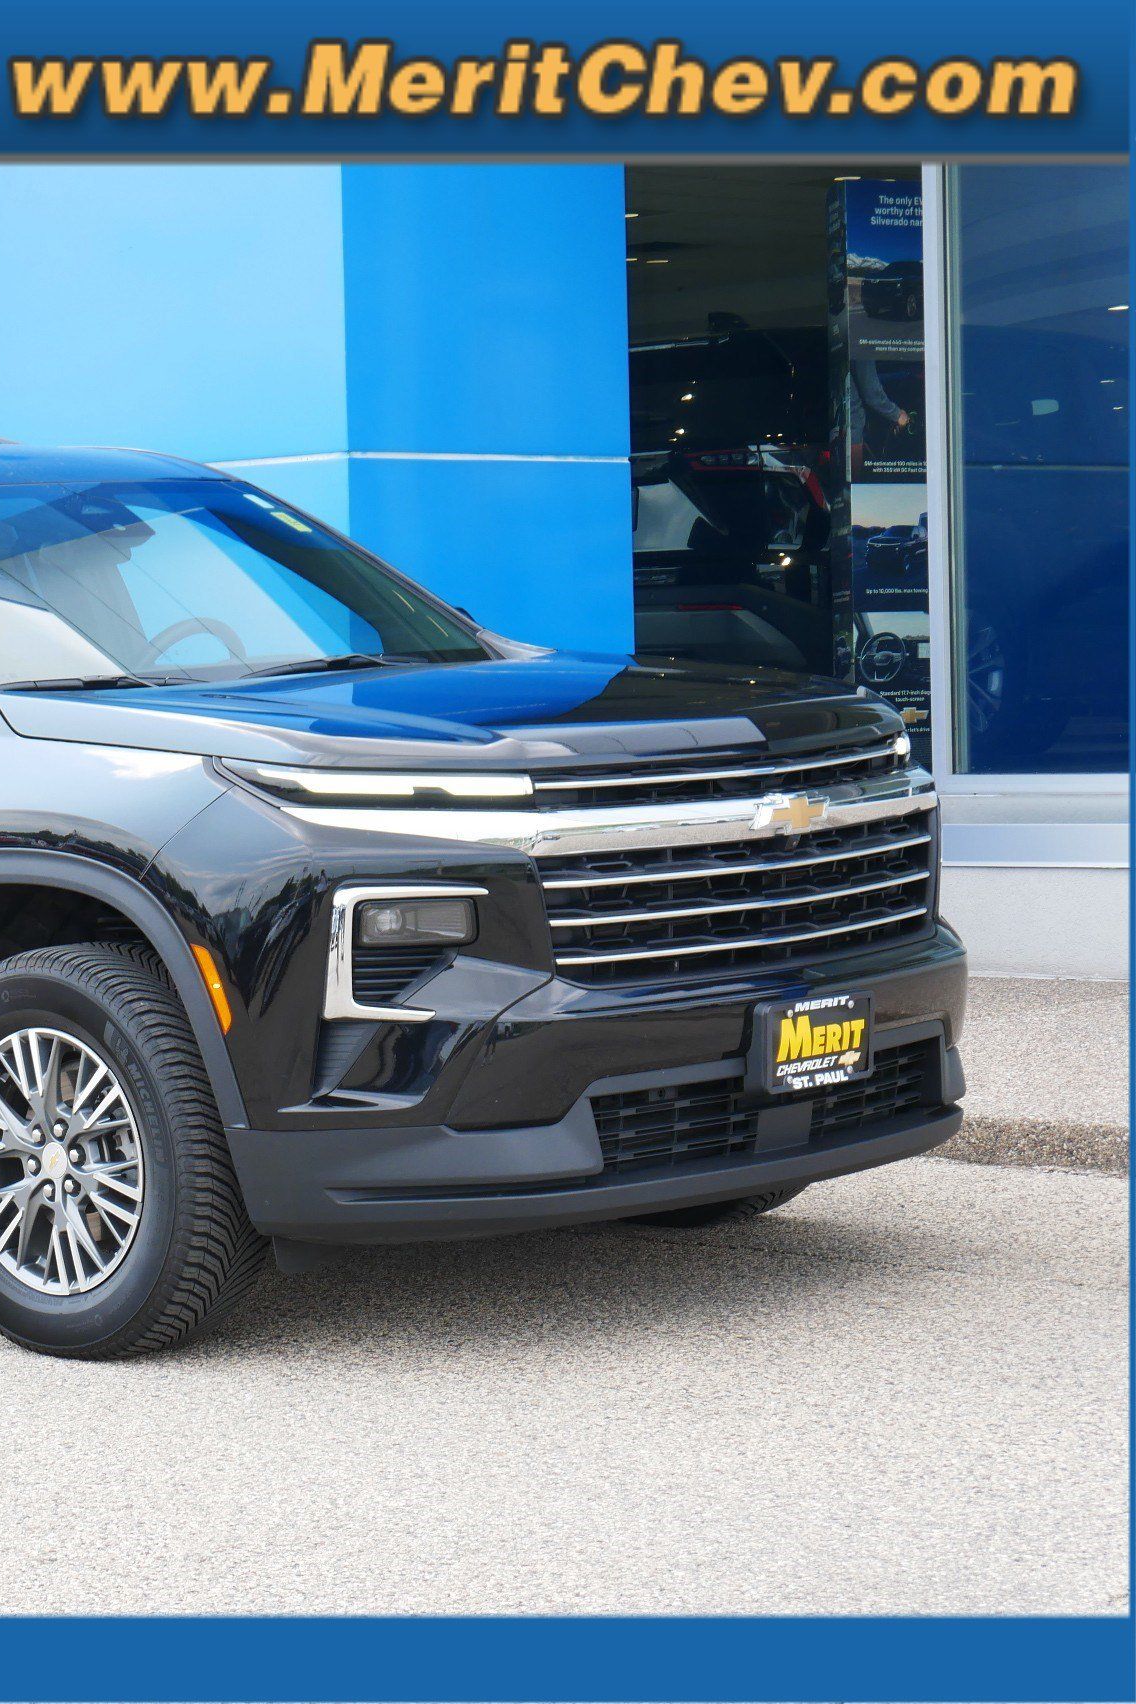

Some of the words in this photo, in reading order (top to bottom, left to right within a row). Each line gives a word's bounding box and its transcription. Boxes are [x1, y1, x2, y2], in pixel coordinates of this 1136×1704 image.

[878, 195, 894, 205] The
[895, 196, 913, 207] only
[874, 206, 904, 217] worthy
[905, 207, 913, 216] of
[870, 216, 909, 226] Silverado
[794, 995, 849, 1013] MERIT
[776, 1015, 865, 1063] MERIT
[776, 1055, 839, 1077] CHEVROLET
[792, 1076, 813, 1089] ST.
[814, 1069, 849, 1086] PAUL
